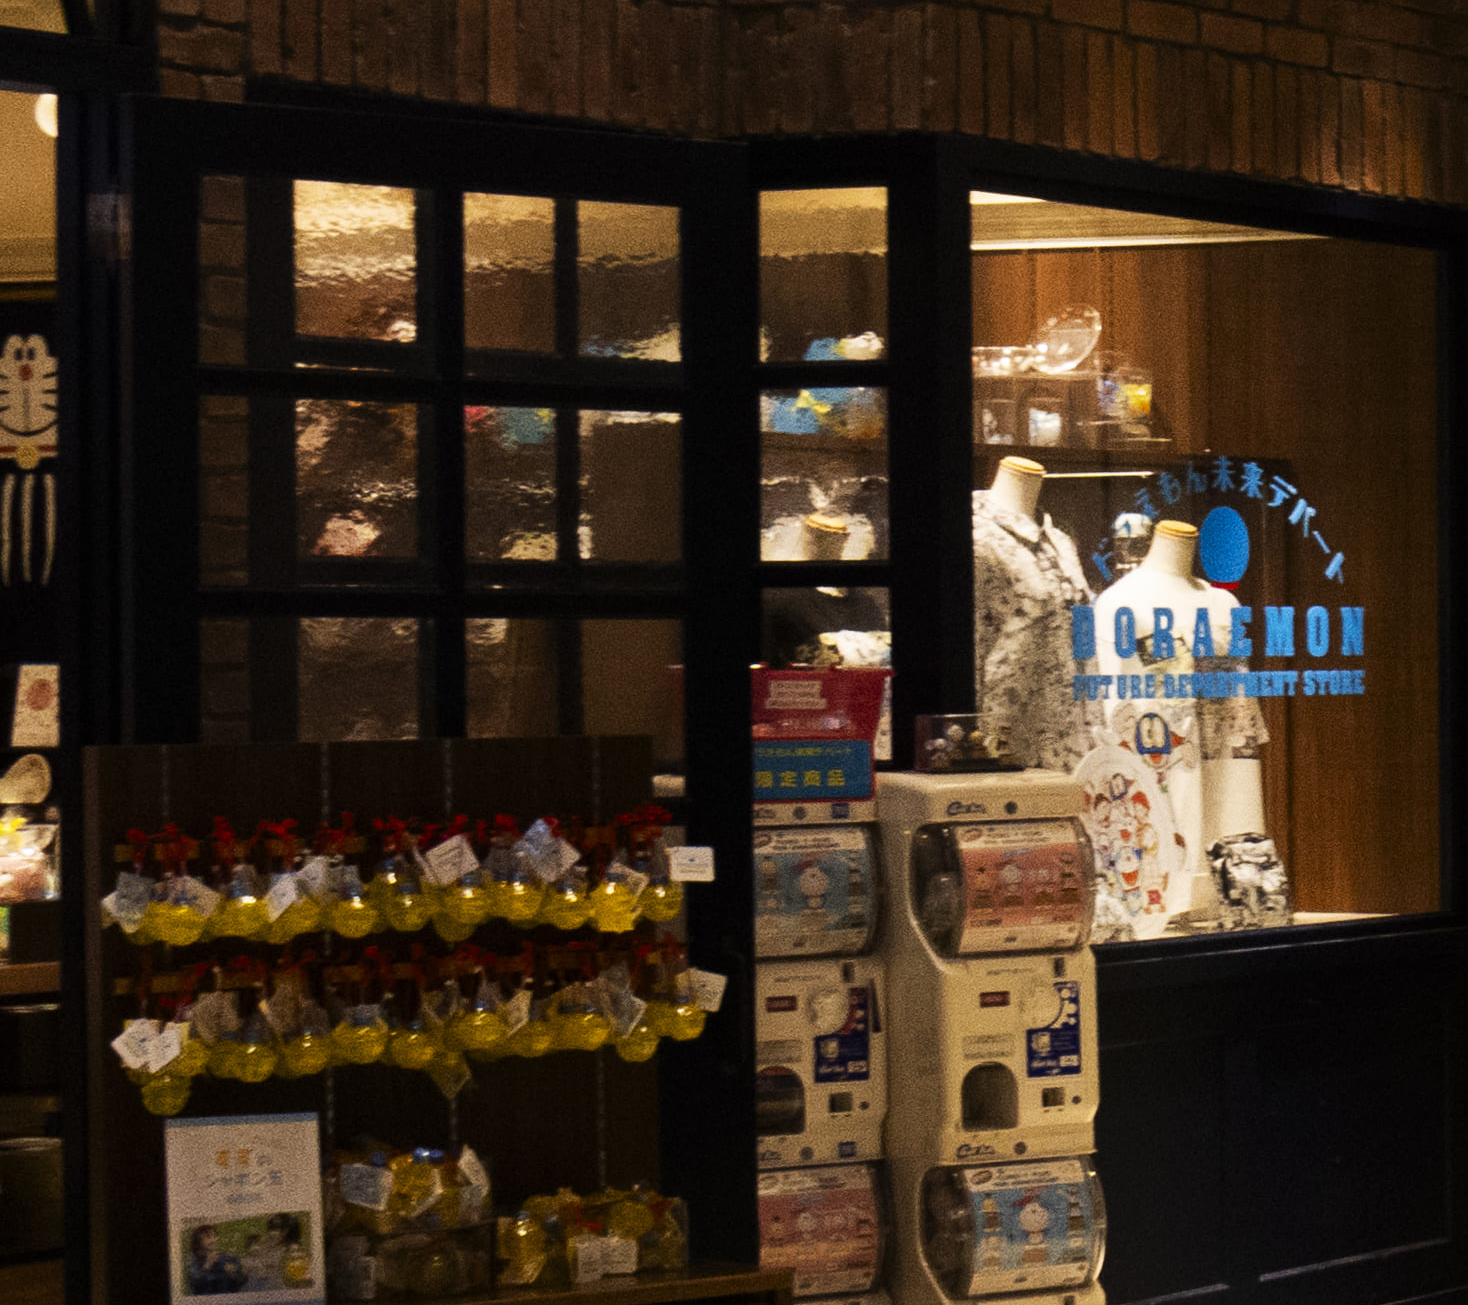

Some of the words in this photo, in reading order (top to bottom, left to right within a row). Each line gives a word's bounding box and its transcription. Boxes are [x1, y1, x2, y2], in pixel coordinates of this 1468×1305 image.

[1071, 605, 1365, 660] DORAEMON
[1073, 674, 1156, 701] FUTURE
[1163, 670, 1298, 699] DEPARTMENT
[1303, 669, 1365, 696] STORE
